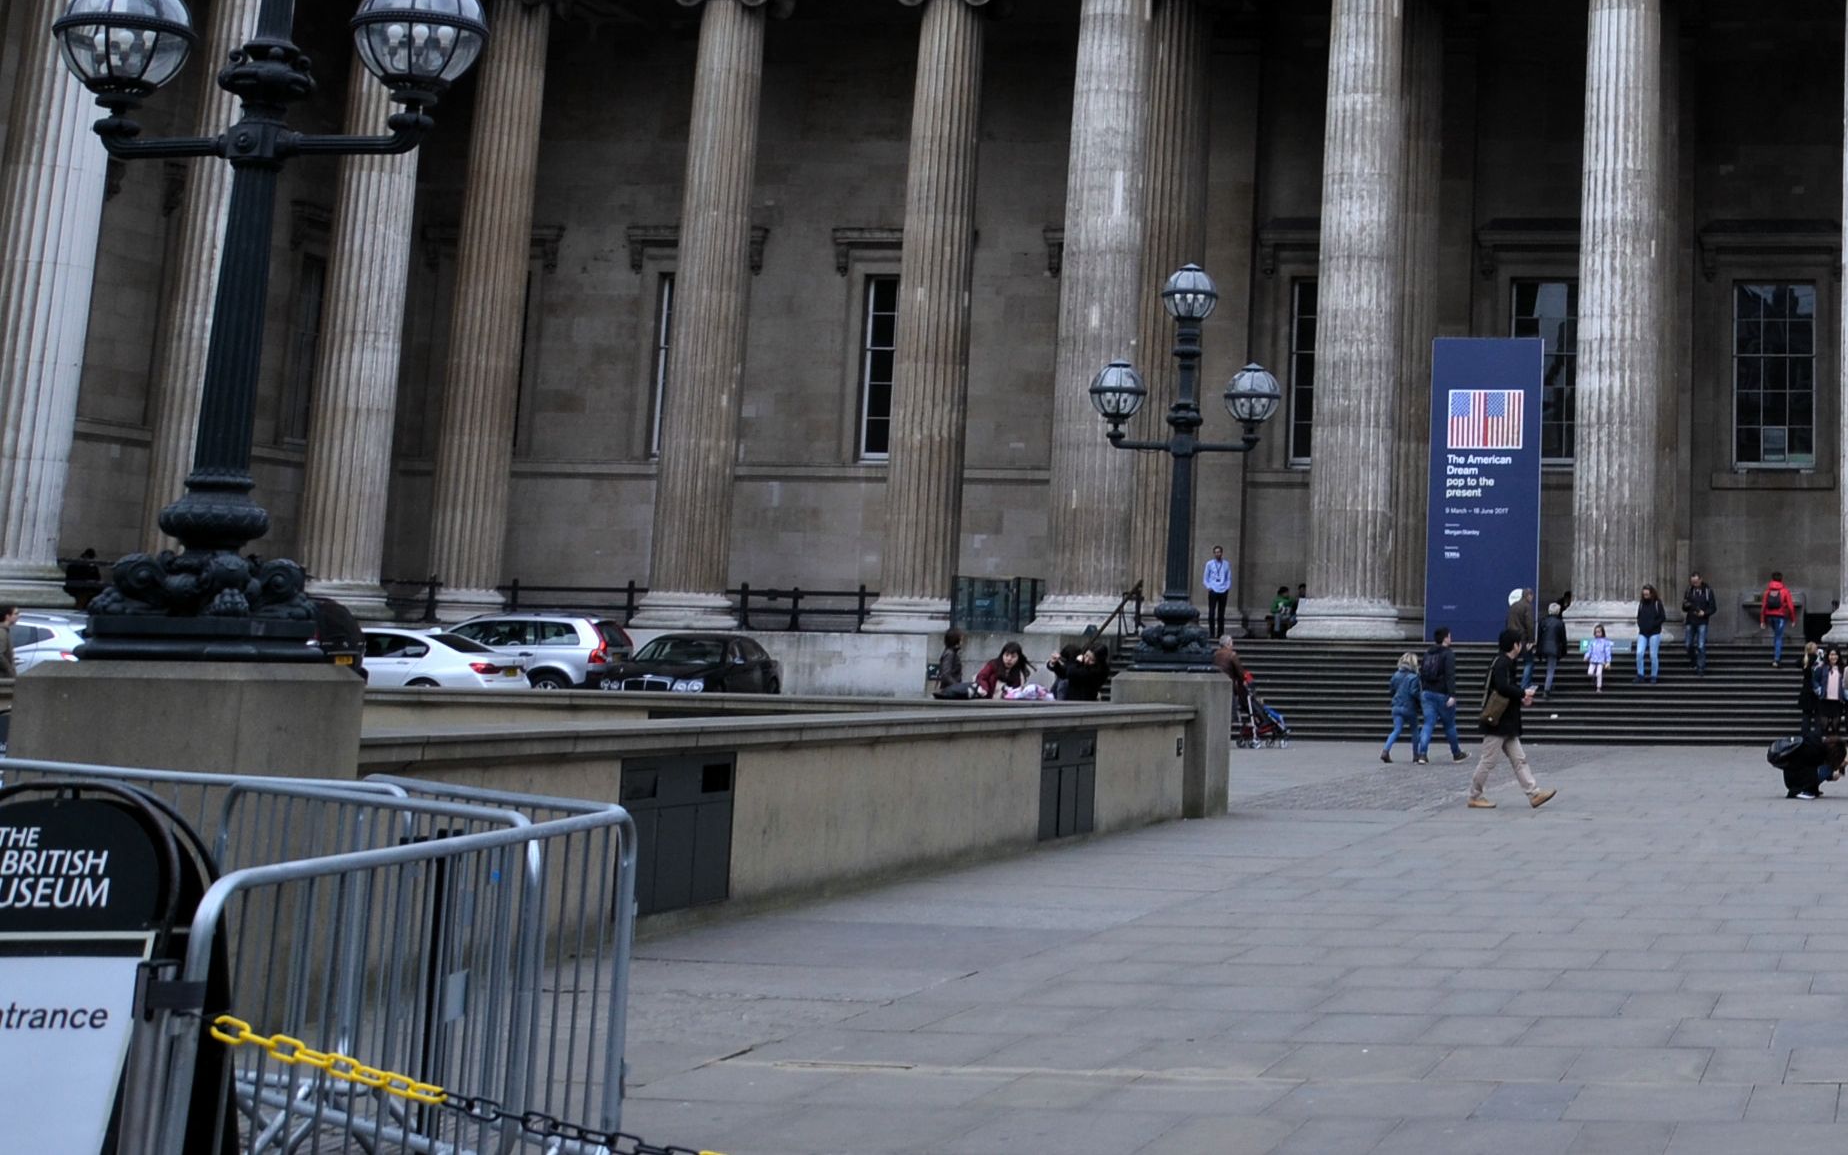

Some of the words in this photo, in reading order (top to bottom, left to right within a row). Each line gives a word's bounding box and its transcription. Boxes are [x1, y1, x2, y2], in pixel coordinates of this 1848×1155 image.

[1447, 454, 1465, 464] The
[1467, 454, 1512, 464] American
[1446, 465, 1478, 475] Dream
[1446, 478, 1465, 487] pop
[1467, 477, 1477, 486] to
[1479, 477, 1495, 486] the
[1446, 488, 1482, 498] present
[0, 826, 41, 848] THE
[0, 849, 108, 876] BRITISH
[0, 877, 110, 908] USEUM
[0, 1001, 109, 1029] trance
